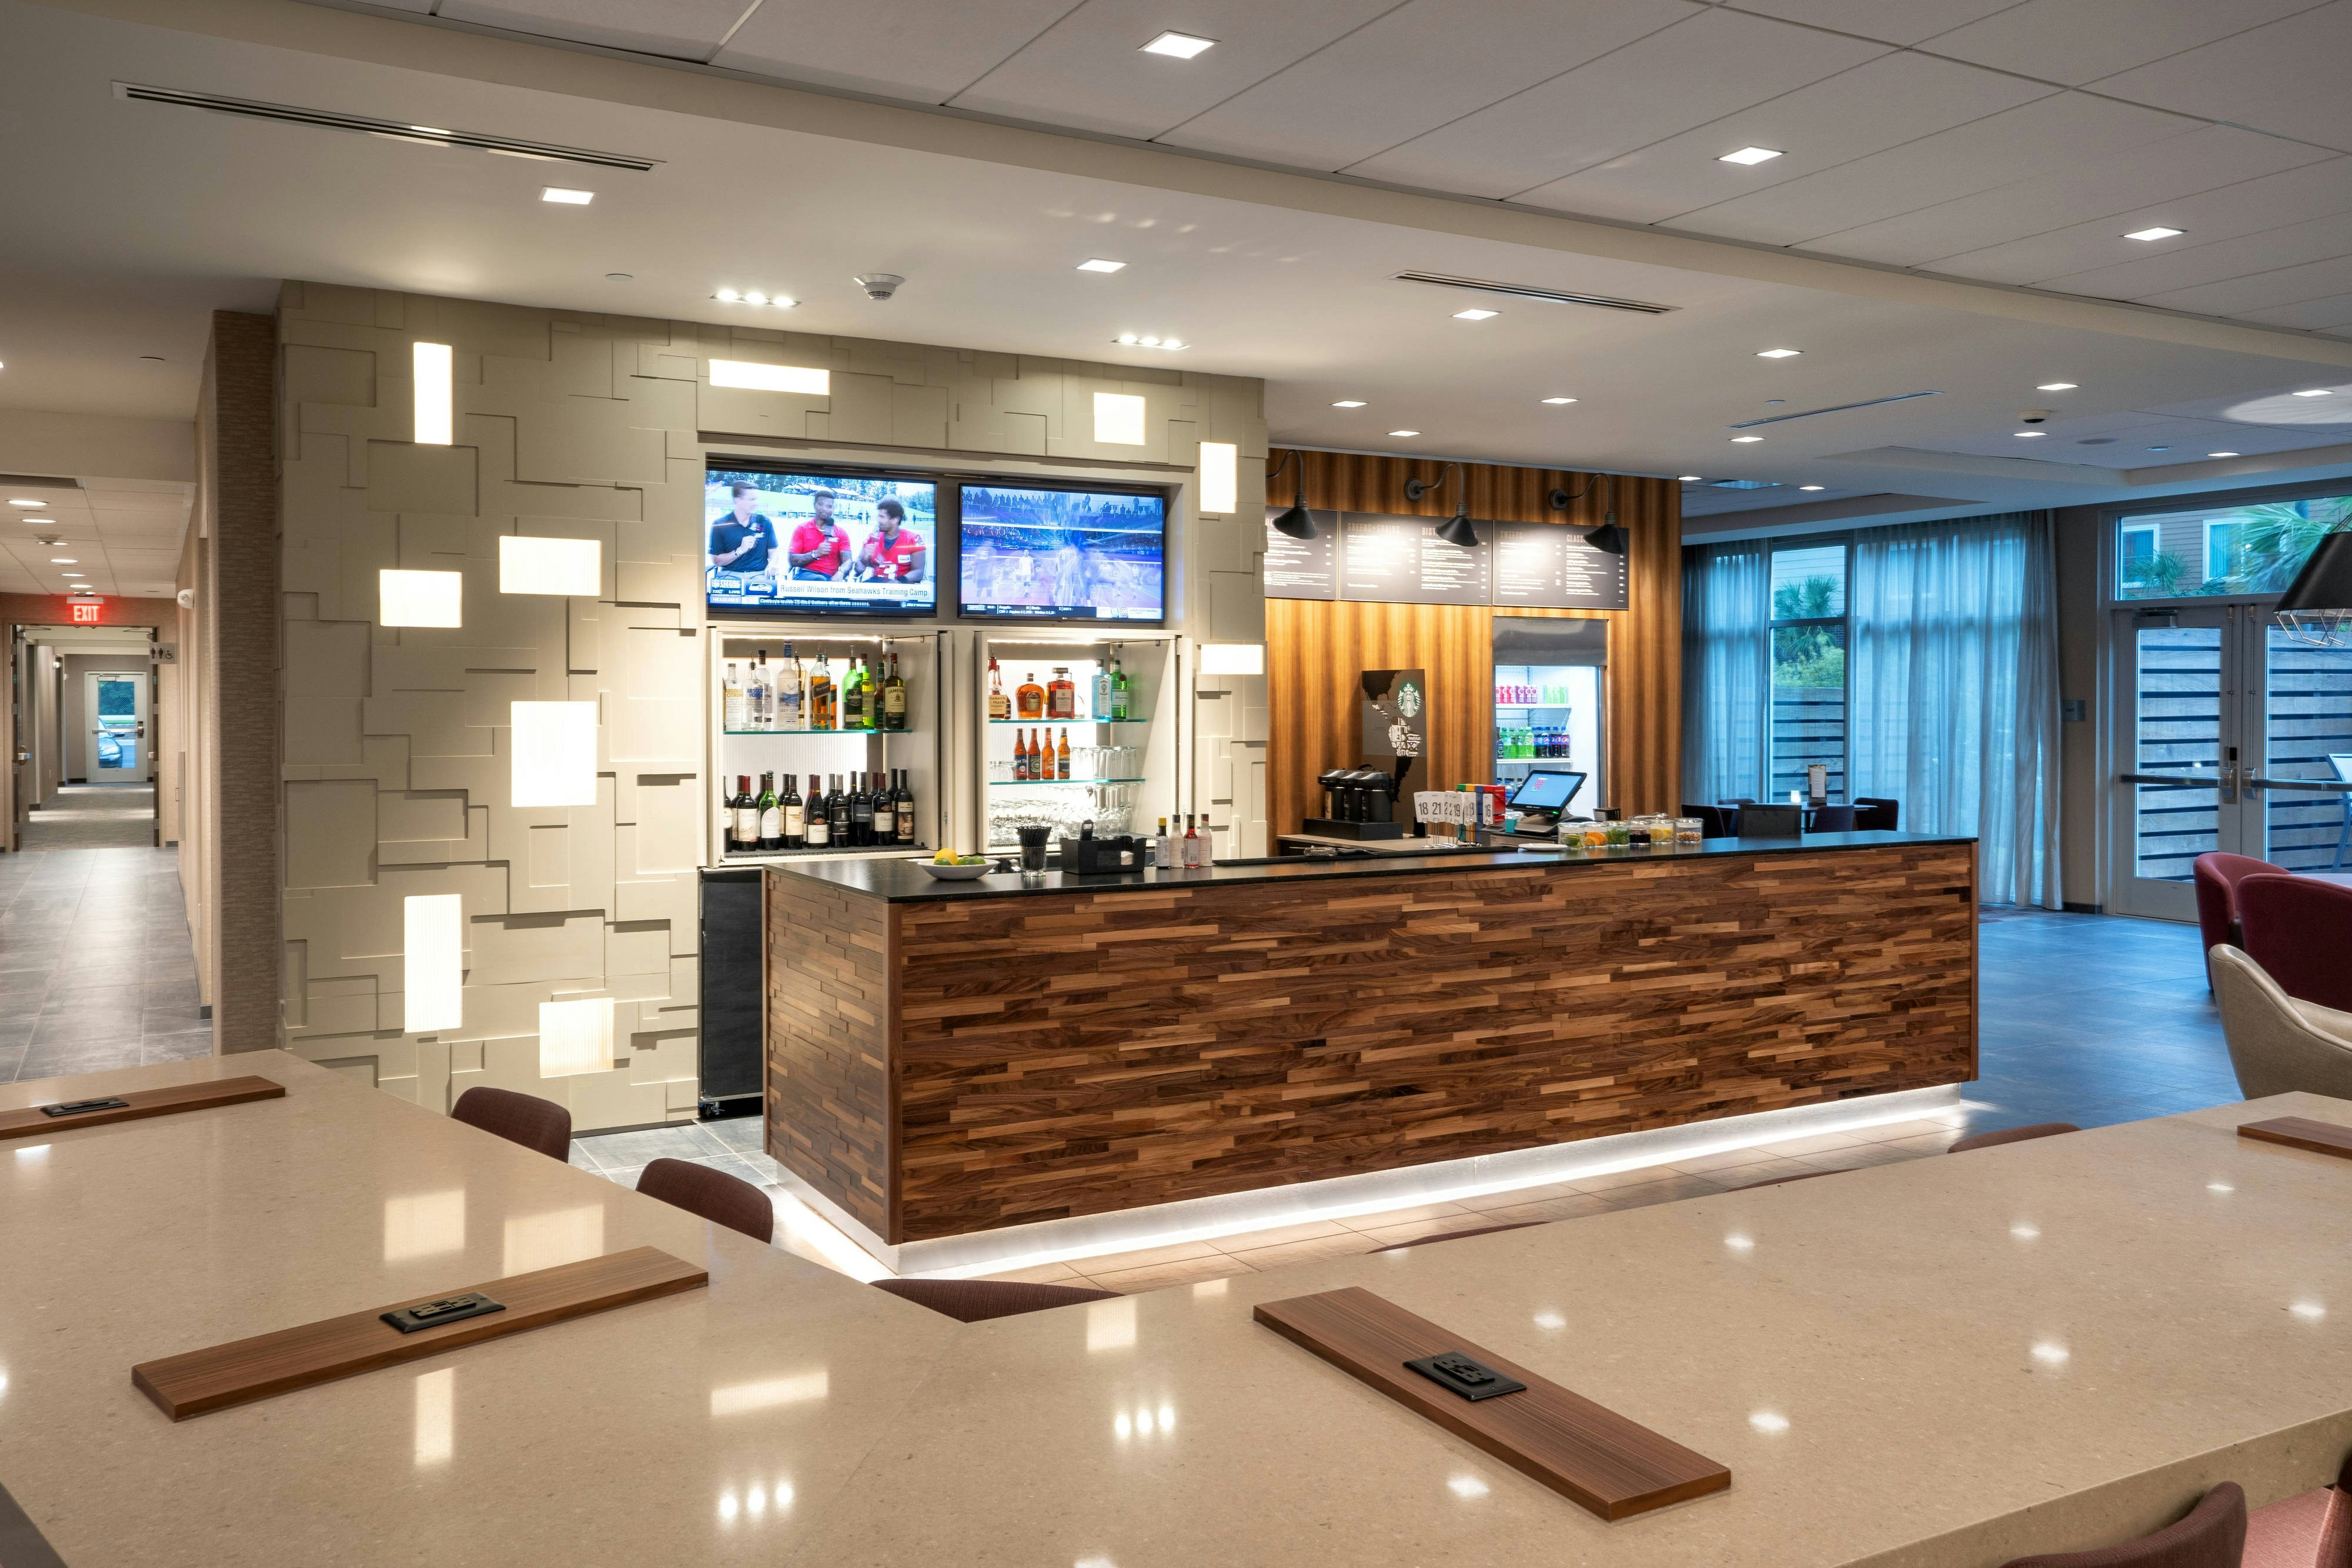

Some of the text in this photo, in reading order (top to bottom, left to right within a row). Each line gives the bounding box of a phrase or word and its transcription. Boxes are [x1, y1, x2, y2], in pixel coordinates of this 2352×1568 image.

[1422, 527, 1438, 536] BIST
[1500, 530, 1524, 539] SWEETS
[1566, 534, 1587, 543] CLASS
[807, 585, 828, 593] Wilson
[847, 587, 880, 595] Seahawks
[882, 588, 908, 597] Training
[909, 589, 928, 597] Camp
[74, 605, 99, 621] EXIT
[1418, 802, 1428, 815] 18
[1432, 802, 1441, 815] 21
[1454, 804, 1460, 817] 19
[1485, 804, 1491, 817] 16
